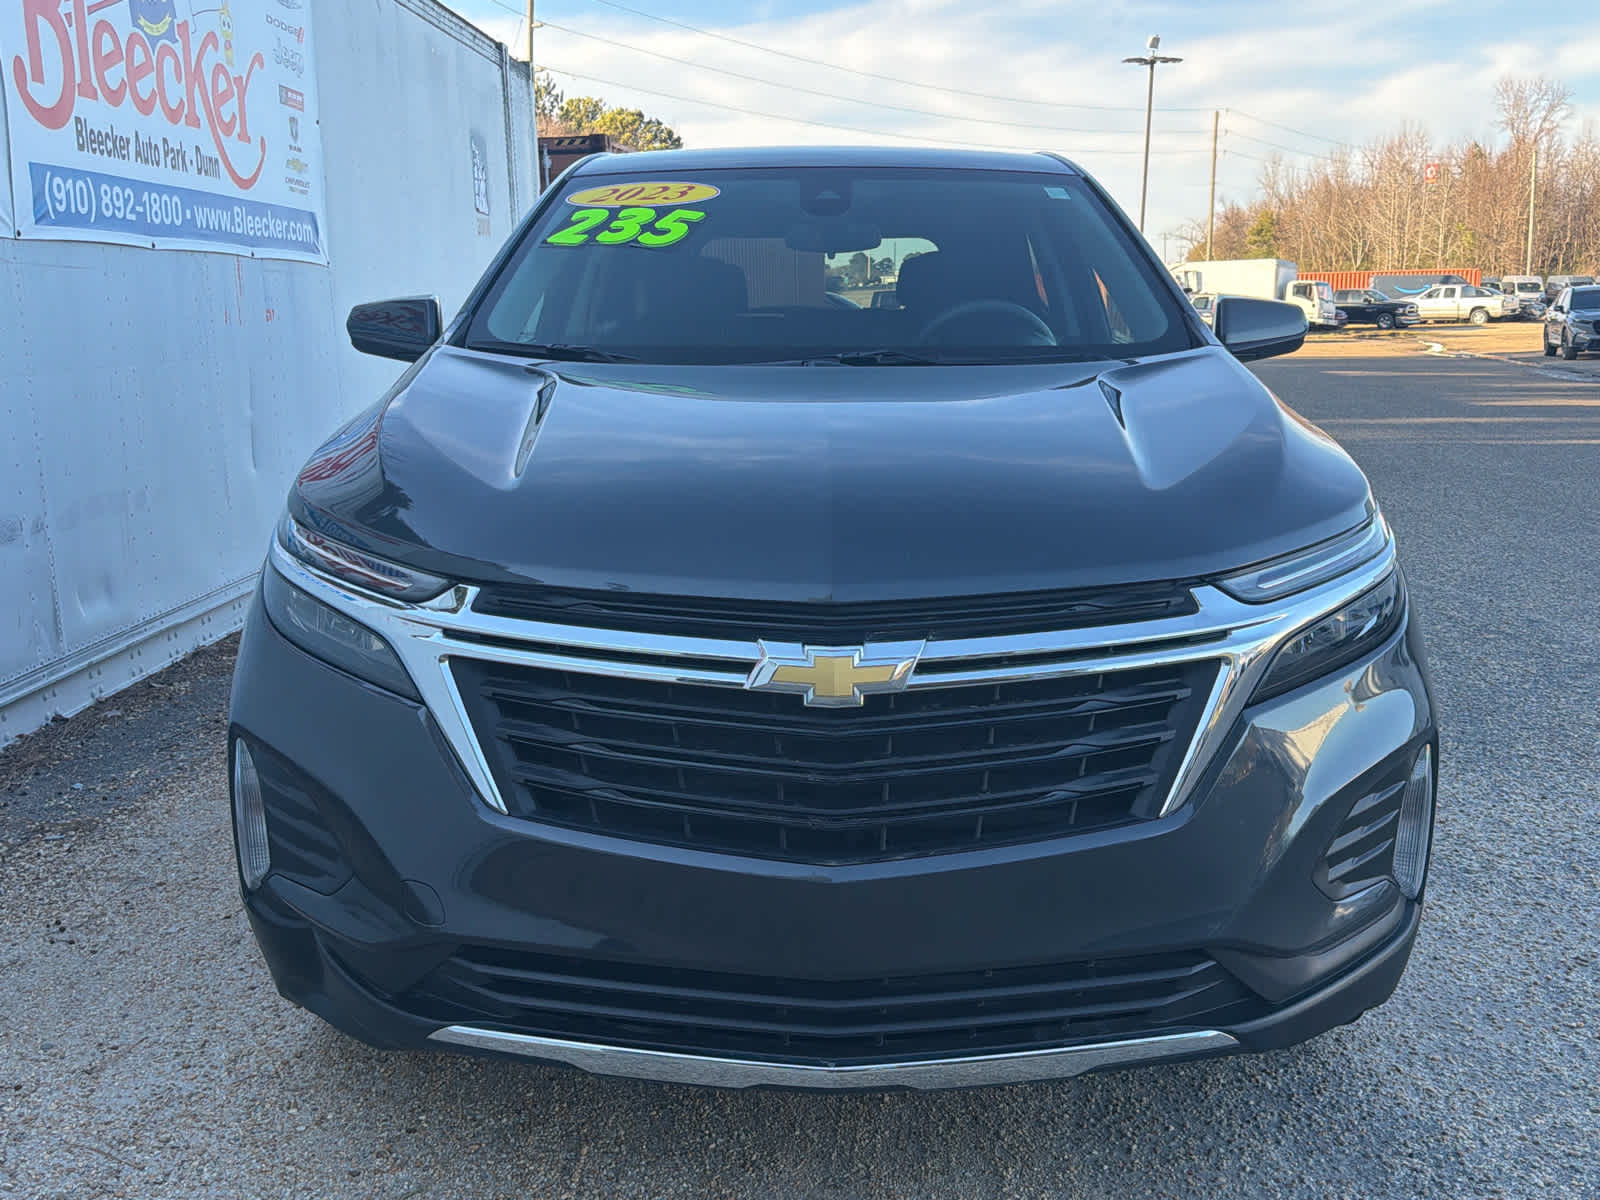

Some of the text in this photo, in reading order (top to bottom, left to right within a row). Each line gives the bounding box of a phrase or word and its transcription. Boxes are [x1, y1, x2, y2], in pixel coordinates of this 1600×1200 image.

[13, 0, 265, 190] Bleecker
[74, 115, 221, 180] Bleecker Auto Park Dunn
[45, 171, 314, 243] (910) 892-1800 www.Bleecker.com
[588, 184, 696, 203] 2023
[546, 207, 706, 247] 235
